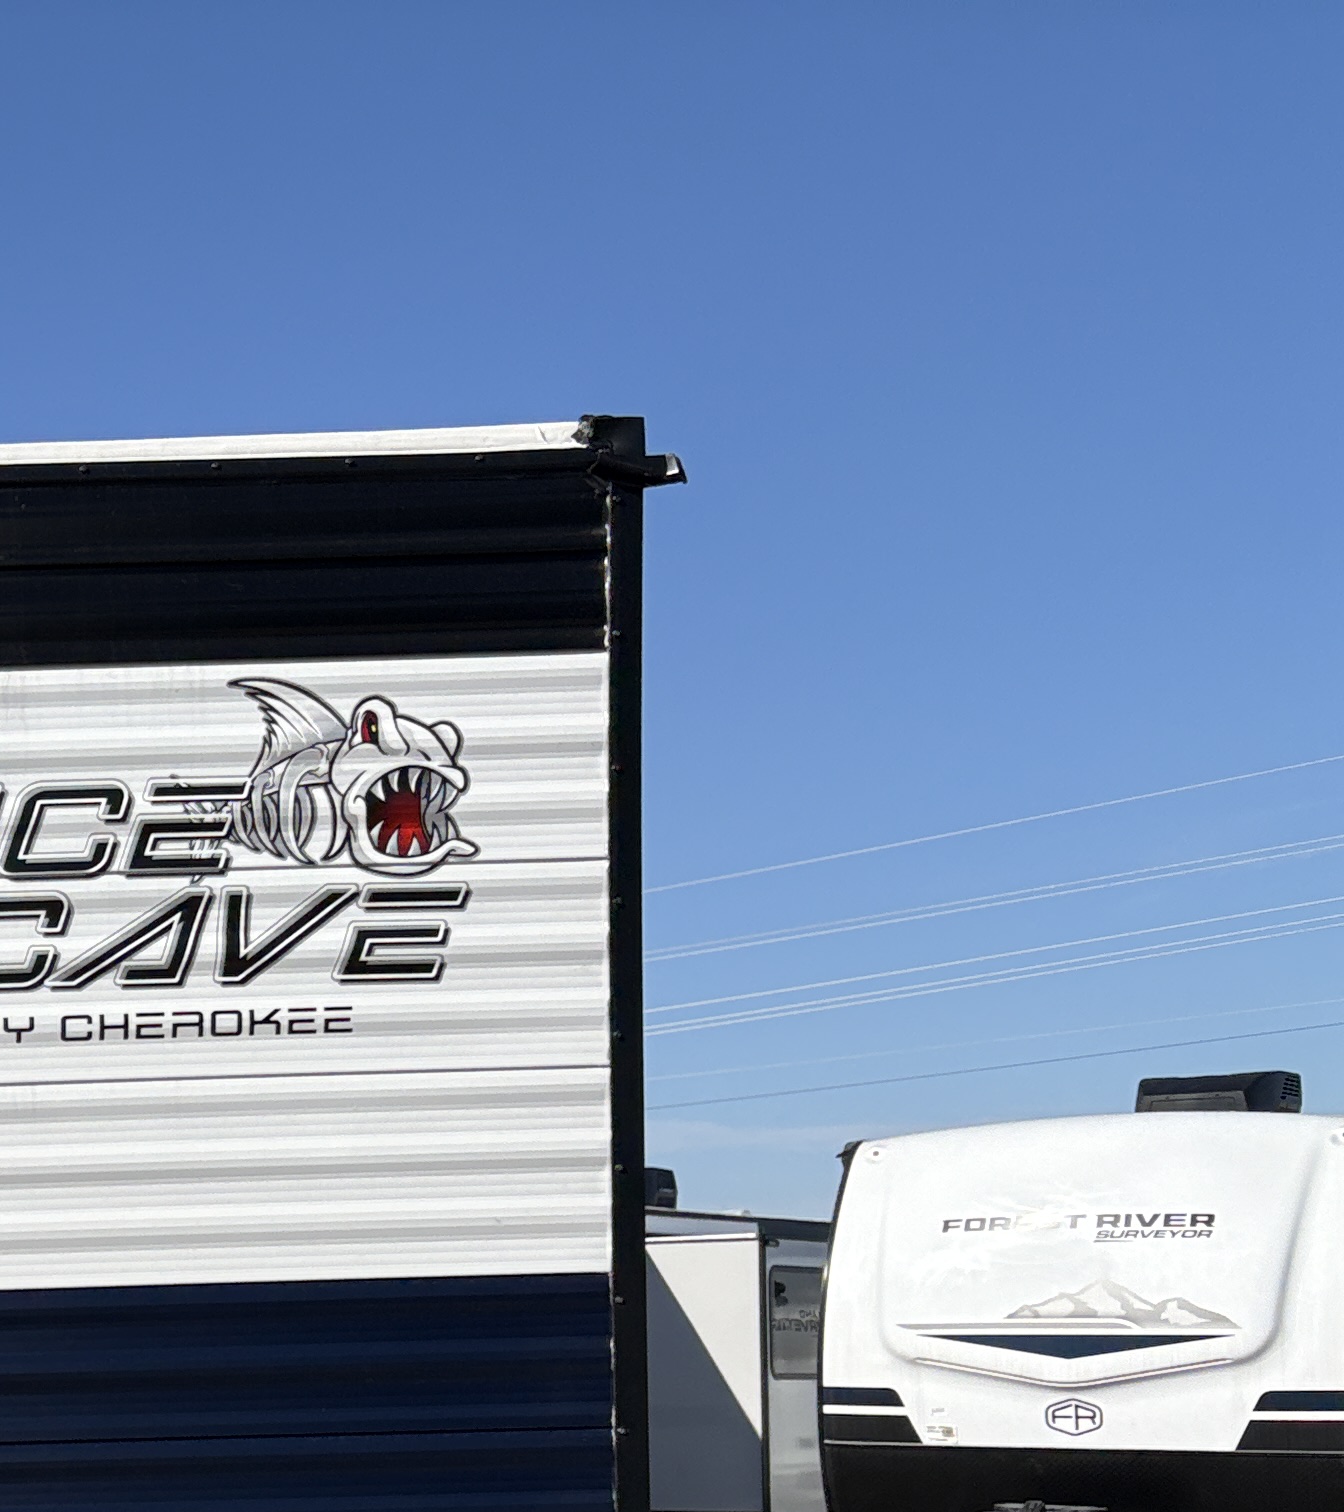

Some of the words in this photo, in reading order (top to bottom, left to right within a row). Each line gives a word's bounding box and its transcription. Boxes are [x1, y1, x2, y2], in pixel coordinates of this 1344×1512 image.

[60, 1006, 354, 1043] CHEROKEE
[942, 1214, 1087, 1233] FORT
[1096, 1213, 1216, 1229] RIVER
[1095, 1229, 1214, 1239] SURVEYOR
[1052, 1403, 1096, 1431] FR
